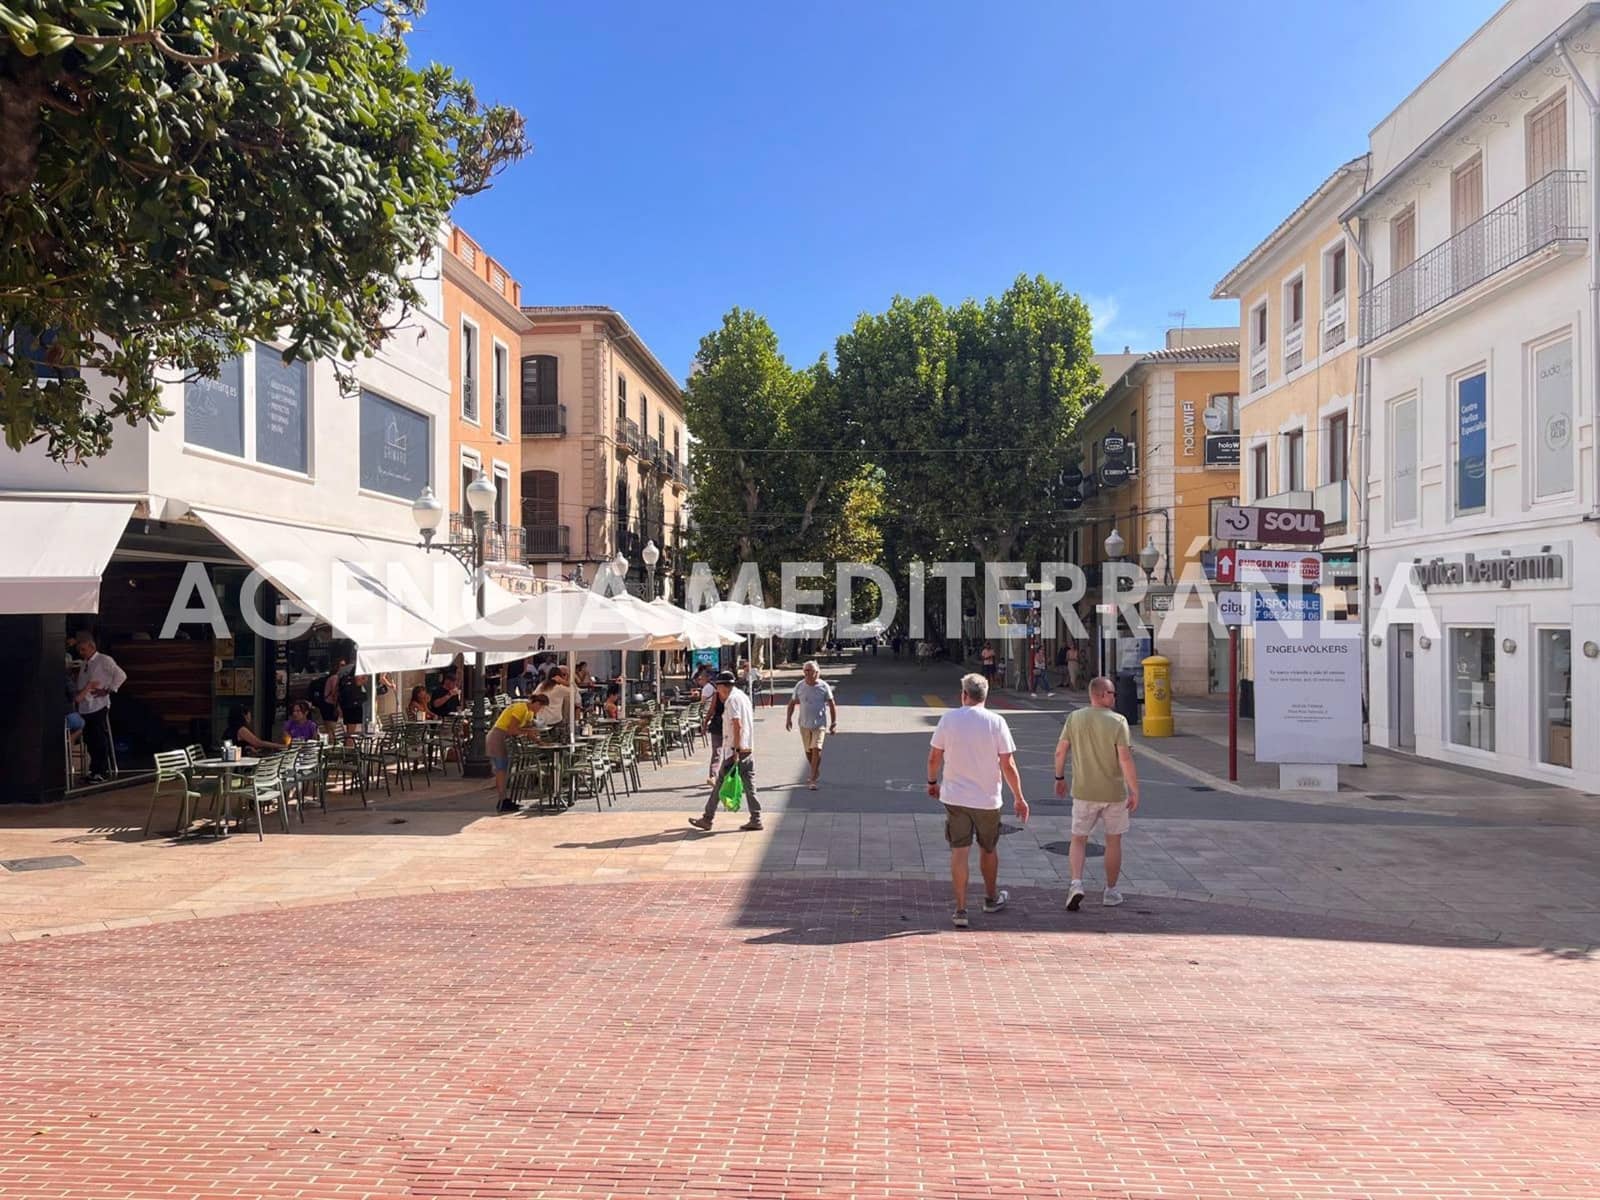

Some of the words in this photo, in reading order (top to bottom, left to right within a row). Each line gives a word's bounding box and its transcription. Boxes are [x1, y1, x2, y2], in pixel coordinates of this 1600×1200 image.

[1264, 511, 1321, 532] SOUL
[1238, 559, 1273, 568] BURGER
[1274, 560, 1297, 569] KING
[1220, 599, 1247, 615] city
[1255, 598, 1320, 610] DISPONIBLE
